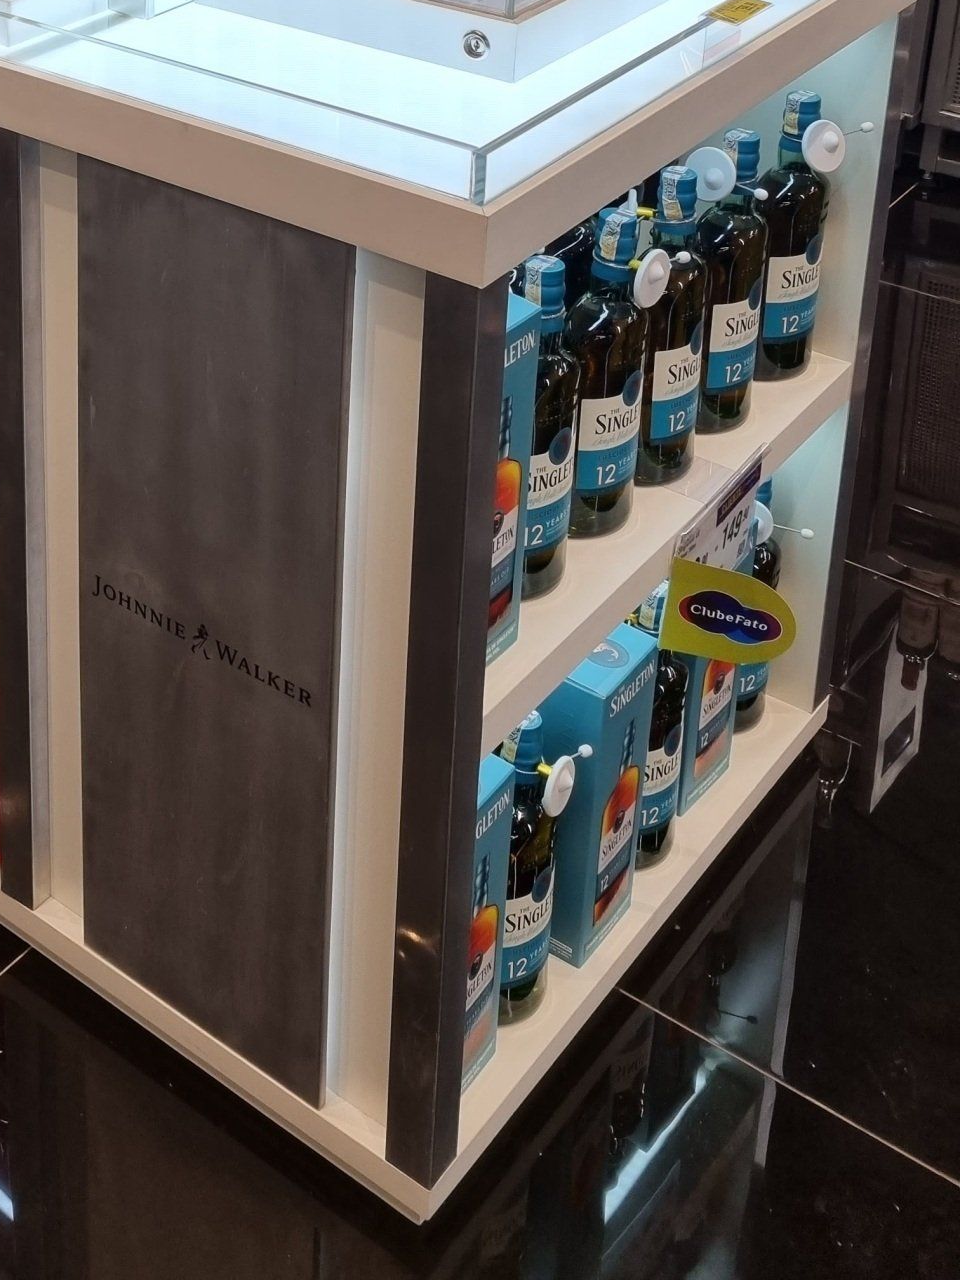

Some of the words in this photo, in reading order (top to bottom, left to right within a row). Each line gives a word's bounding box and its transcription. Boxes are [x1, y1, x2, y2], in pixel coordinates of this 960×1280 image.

[781, 315, 799, 334] 12
[503, 329, 536, 369] LETON
[724, 363, 742, 384] 12
[594, 404, 640, 435] SINGLE
[610, 407, 620, 415] THE
[668, 410, 686, 432] 12
[536, 466, 547, 474] THE
[596, 463, 616, 486] 12
[491, 526, 515, 555] LETON
[524, 524, 544, 547] 12
[689, 603, 769, 632] ClubeFato
[92, 574, 186, 641] JOHNNIE
[215, 639, 313, 708] WALKER
[609, 659, 656, 718] SINGLETON
[739, 674, 755, 693] 12
[702, 683, 732, 718] SINGLETON
[700, 733, 709, 748] 12
[644, 754, 681, 784] SINGLE
[476, 789, 510, 840] GLETON
[641, 806, 659, 826] 12
[601, 818, 633, 862] SINGLETON
[600, 873, 609, 888] 12
[467, 961, 492, 998] GLETON
[507, 958, 527, 979] 12
